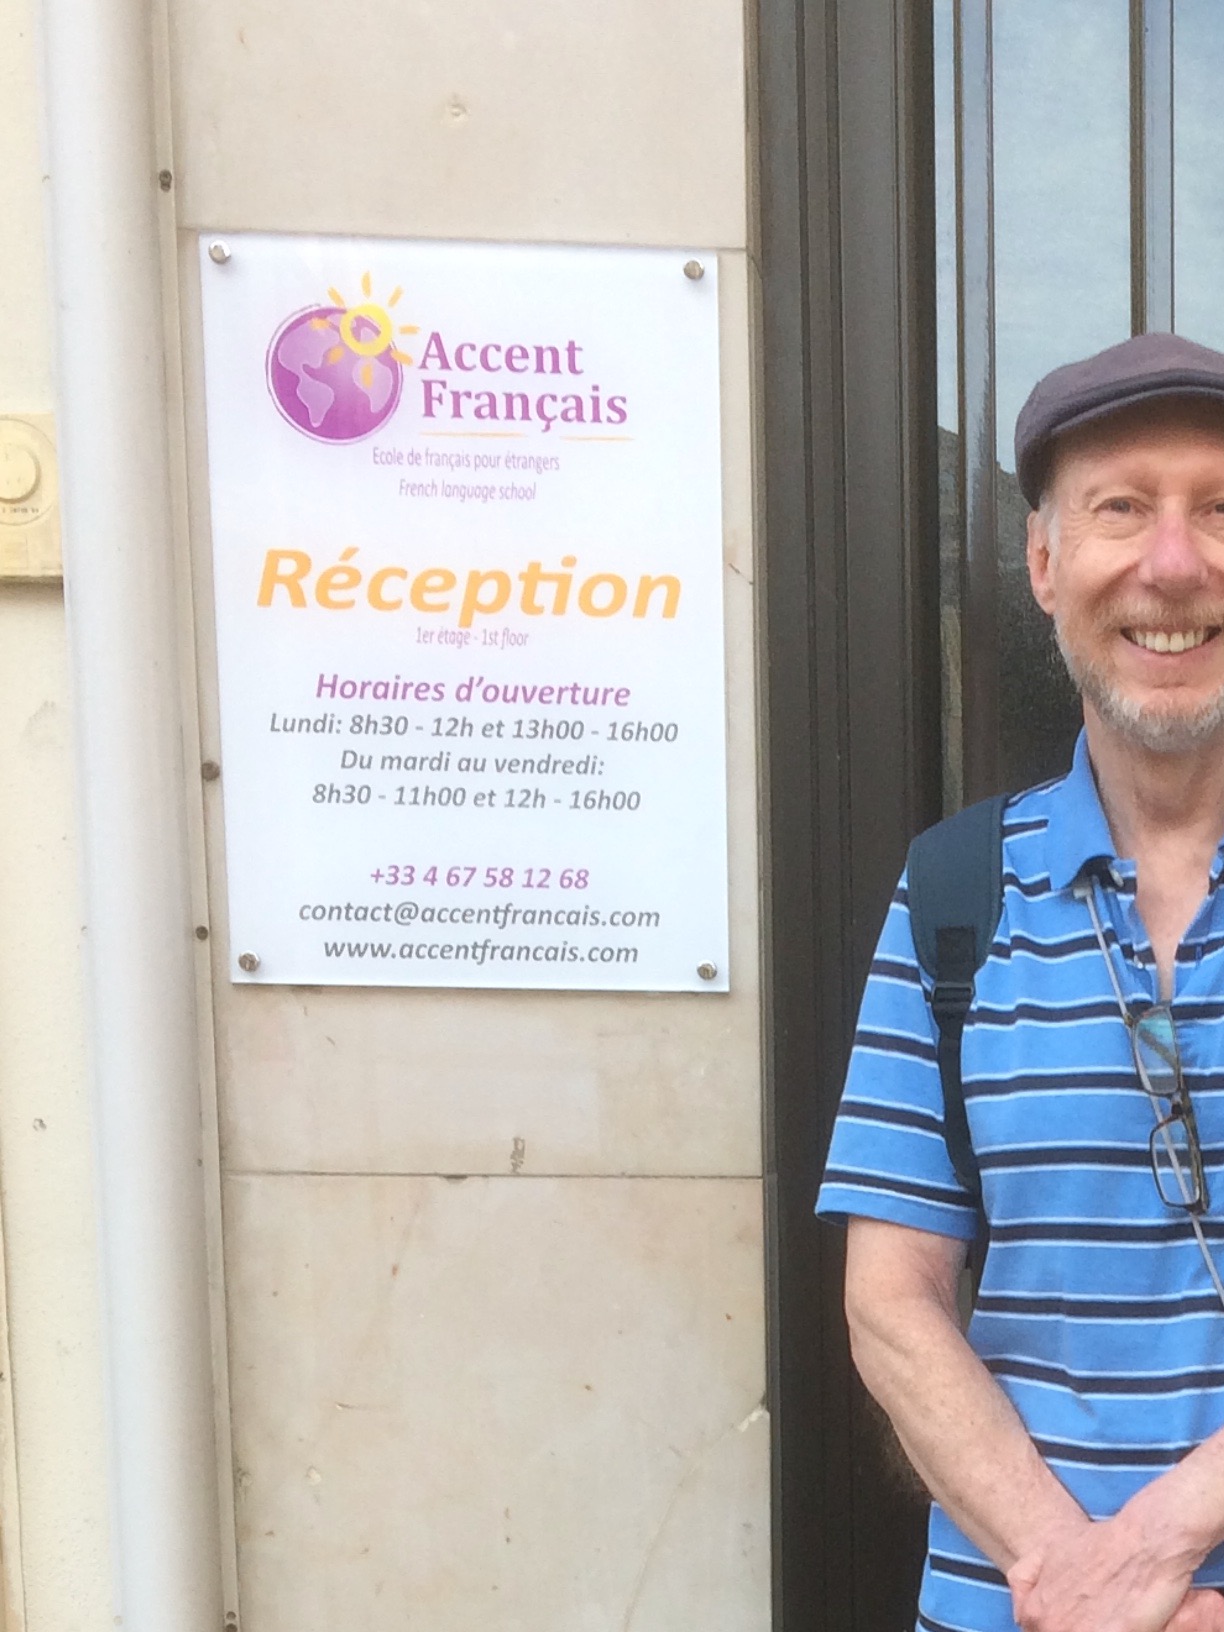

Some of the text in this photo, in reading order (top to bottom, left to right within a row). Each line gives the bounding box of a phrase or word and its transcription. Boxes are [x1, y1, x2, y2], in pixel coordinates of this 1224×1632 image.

[419, 332, 583, 375] Accent
[422, 380, 627, 432] Français
[407, 448, 422, 466] de
[425, 448, 470, 471] français
[474, 455, 501, 471] pour
[504, 451, 560, 475] étrangers
[399, 479, 536, 503] French language school
[257, 547, 681, 628] Réception
[416, 626, 434, 644] 1er
[438, 626, 471, 649] étage
[482, 628, 499, 646] 1st
[501, 627, 529, 650] floor
[316, 674, 445, 701] Horaires
[270, 713, 341, 734] Lundi:
[350, 714, 408, 735] 8h30
[432, 716, 473, 737] 12h
[482, 720, 505, 738] et
[512, 719, 584, 740] 13h00
[607, 721, 678, 742] 16h00
[341, 750, 604, 775] Du mardi au vendredi:
[313, 783, 371, 804] 8h30
[394, 785, 466, 806] 11h00
[473, 790, 496, 807] et
[505, 788, 546, 808] 12h
[570, 790, 641, 810] 16h00
[371, 865, 589, 889] +33 4 67 58 12 68
[299, 902, 660, 929] contact@accentfrancais.com
[324, 939, 638, 965] www.accentfrancais.com
